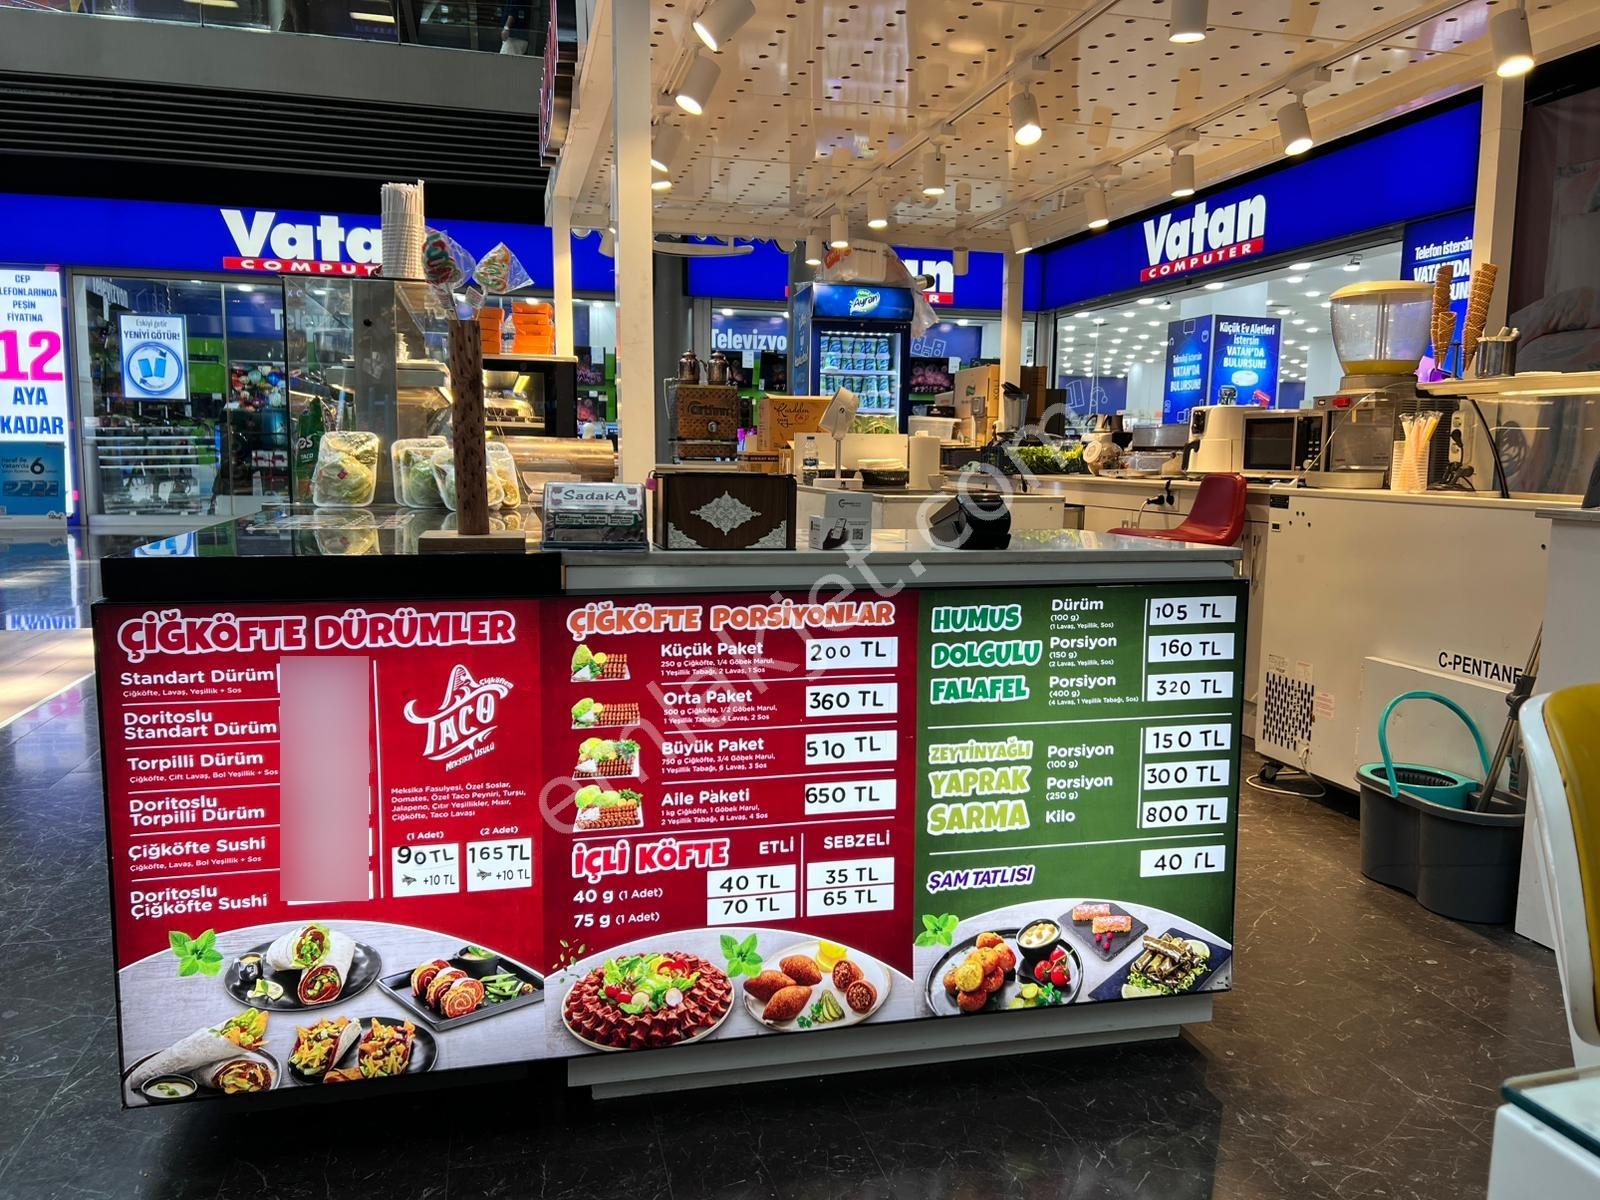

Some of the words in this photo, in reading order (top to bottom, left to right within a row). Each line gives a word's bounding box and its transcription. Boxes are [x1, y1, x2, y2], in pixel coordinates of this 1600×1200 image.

[220, 208, 382, 264] Vata
[1143, 194, 1266, 266] Vatan
[1415, 243, 1443, 261] Telefon
[1443, 236, 1473, 255] istersin
[240, 259, 382, 277] COMPUT
[1148, 242, 1252, 278] COMPUTER
[14, 274, 31, 283] CEP
[12, 298, 36, 310] PEŞİN
[852, 294, 879, 309] Ayran
[7, 312, 43, 323] FİYATINA
[123, 329, 150, 340] YENİYİ
[150, 330, 180, 341] GÖTÜR!
[1219, 321, 1240, 335] Küçük
[1241, 323, 1250, 334] Ev
[1250, 324, 1275, 336] Aletleri
[711, 328, 788, 351] Televizyo
[0, 329, 63, 381] 12
[1226, 345, 1265, 358] VATAN'DA
[1223, 357, 1267, 369] BULURSUN!
[12, 386, 48, 405] AYA
[0, 415, 64, 435] KADAR
[30, 457, 45, 475] 6
[563, 489, 626, 501] SadakA
[1052, 598, 1104, 611] Dürüm
[1155, 603, 1187, 620] 105
[1200, 603, 1222, 618] TL
[566, 600, 702, 641] ÇİĞKÖFTE
[710, 598, 895, 632] PORSİYONLAR
[931, 604, 1022, 633] HUMUS
[1050, 614, 1070, 622] (100
[1070, 614, 1080, 622] g)
[117, 608, 306, 663] ÇİĞKÖFTE
[315, 607, 516, 650] DÜRÜMLER
[1050, 635, 1117, 650] Porsiyon
[661, 643, 712, 659] Küçük
[717, 642, 764, 656] Paket
[811, 644, 850, 661] 200
[860, 641, 886, 657] TL
[931, 639, 1043, 669] DOLGULU
[1049, 651, 1068, 659] (150
[1068, 651, 1077, 659] g)
[1160, 639, 1192, 657] 160
[1199, 641, 1221, 656] TL
[1438, 651, 1523, 684] C-PENTANE
[121, 671, 205, 686] Standart
[211, 668, 274, 683] Dürüm
[1049, 674, 1117, 689] Porsiyon
[122, 689, 161, 699] Çiğköfte,
[190, 687, 218, 697] Yeşillik
[930, 675, 1030, 705] FALAFEL
[1049, 690, 1071, 698] (400
[1071, 690, 1081, 698] g)
[1156, 680, 1191, 696] 320
[1200, 679, 1222, 694] TL
[663, 692, 702, 706] Orta
[707, 690, 753, 705] Paket
[809, 692, 850, 711] 360
[858, 691, 883, 707] TL
[124, 709, 213, 725] Doritoslu
[421, 692, 495, 758] TACO
[124, 725, 208, 741] Standart
[214, 721, 277, 736] Dürüm
[1153, 731, 1192, 749] 150
[1199, 730, 1225, 747] TL
[661, 740, 714, 757] Büyük
[718, 737, 765, 752] Paket
[806, 740, 845, 759] 510
[854, 736, 881, 752] TL
[928, 736, 1033, 764] ZEYTİNYAĞLI
[1047, 743, 1114, 759] Porsiyon
[127, 754, 194, 772] Torpilli
[200, 752, 264, 768] Dürüm
[1046, 760, 1067, 770] (100
[1068, 759, 1079, 769] g)
[928, 766, 1032, 799] YAPRAK
[1046, 774, 1113, 790] Porsiyon
[1147, 767, 1188, 784] 300
[1195, 765, 1221, 782] TL
[391, 787, 423, 795] Meksika
[425, 784, 464, 793] Fasulyesi,
[465, 783, 483, 791] Özel
[486, 781, 511, 789] Soslar,
[806, 786, 846, 804] 650
[854, 785, 880, 802] TL
[1046, 791, 1067, 801] (250
[1068, 791, 1079, 800] g)
[129, 795, 218, 813] Doritoslu
[661, 792, 695, 807] Aile
[699, 788, 750, 804] Paketi
[129, 809, 196, 827] Torpilli
[202, 806, 265, 822] Dürüm
[927, 799, 1031, 836] SARMA
[1045, 809, 1076, 824] Kilo
[1146, 805, 1188, 823] 800
[1196, 804, 1221, 821] TL
[406, 832, 415, 841] (1
[417, 831, 444, 840] Adet)
[480, 827, 490, 836] (2
[492, 825, 519, 835] Adet)
[823, 829, 890, 849] SEBZELİ
[128, 842, 211, 861] Çiğköfte
[216, 836, 266, 852] Sushi
[468, 846, 503, 863] 165
[507, 844, 530, 861] TL
[759, 836, 794, 854] ETLİ
[396, 846, 427, 865] 90
[429, 848, 454, 863] TL
[571, 839, 630, 884] İÇLİ
[635, 837, 730, 874] KÖFTE
[1154, 853, 1183, 871] 40
[423, 874, 440, 886] +10
[443, 874, 456, 885] TL
[495, 869, 514, 881] +10
[518, 868, 530, 880] TL
[720, 875, 749, 893] 40
[756, 874, 780, 889] TL
[825, 868, 848, 884] 35
[856, 867, 879, 882] TL
[926, 869, 970, 894] ŞAM
[971, 864, 1035, 888] TATLISI
[130, 885, 218, 904] Doritoslu
[573, 889, 597, 904] 40
[602, 890, 614, 904] g
[618, 889, 628, 901] (1
[631, 887, 664, 899] Adet)
[823, 891, 847, 906] 65
[854, 888, 877, 904] TL
[130, 900, 212, 920] Çiğköfte
[218, 894, 268, 910] Sushi
[723, 899, 748, 915] 70
[755, 897, 780, 912] TL
[573, 913, 594, 928] 75
[599, 914, 611, 928] g
[615, 914, 625, 926] (1
[628, 912, 660, 924] Adet)
